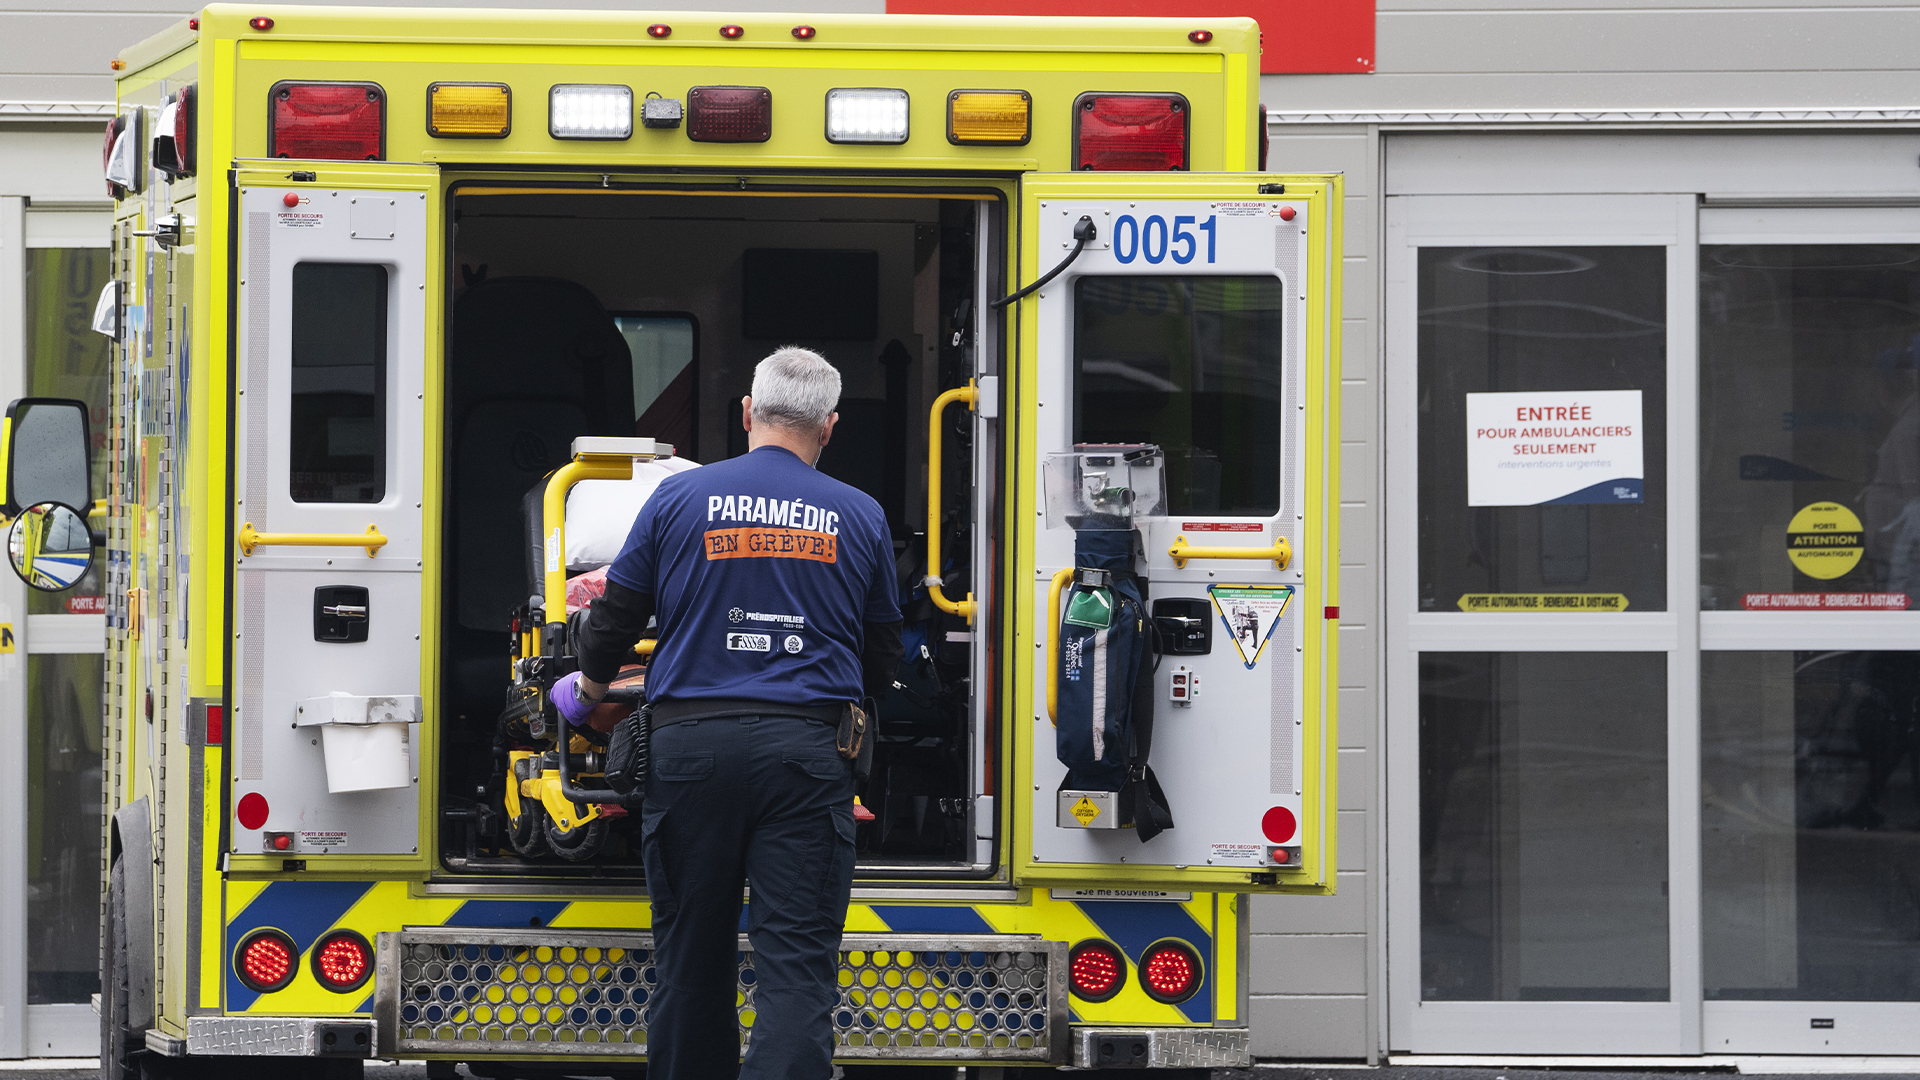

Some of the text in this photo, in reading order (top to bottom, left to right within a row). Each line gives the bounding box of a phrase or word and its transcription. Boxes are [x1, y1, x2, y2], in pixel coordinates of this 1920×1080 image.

[1113, 214, 1216, 264] 0051
[1516, 402, 1592, 422] ENTRÉE
[1477, 426, 1632, 439] POUR AMBULANCIERS
[1513, 443, 1597, 455] SEULEMENT
[1497, 459, 1612, 470] interventions urgentes
[708, 495, 839, 536] PARAMÉDIC
[709, 529, 833, 558] EN GRÈVE!
[1793, 535, 1857, 545] ATTENTION
[72, 597, 94, 609] PORTE
[1467, 596, 1490, 608] PORTE
[1491, 596, 1538, 608] AUTOMATIQUE
[1543, 596, 1579, 608] DEMEUREZ
[1586, 596, 1620, 608] DISTANCE
[1746, 594, 1769, 607] PORTE
[1770, 594, 1821, 607] AUTOMATIQUE
[1825, 594, 1863, 607] DEMEUREZ
[1870, 594, 1905, 607] DISTANCE
